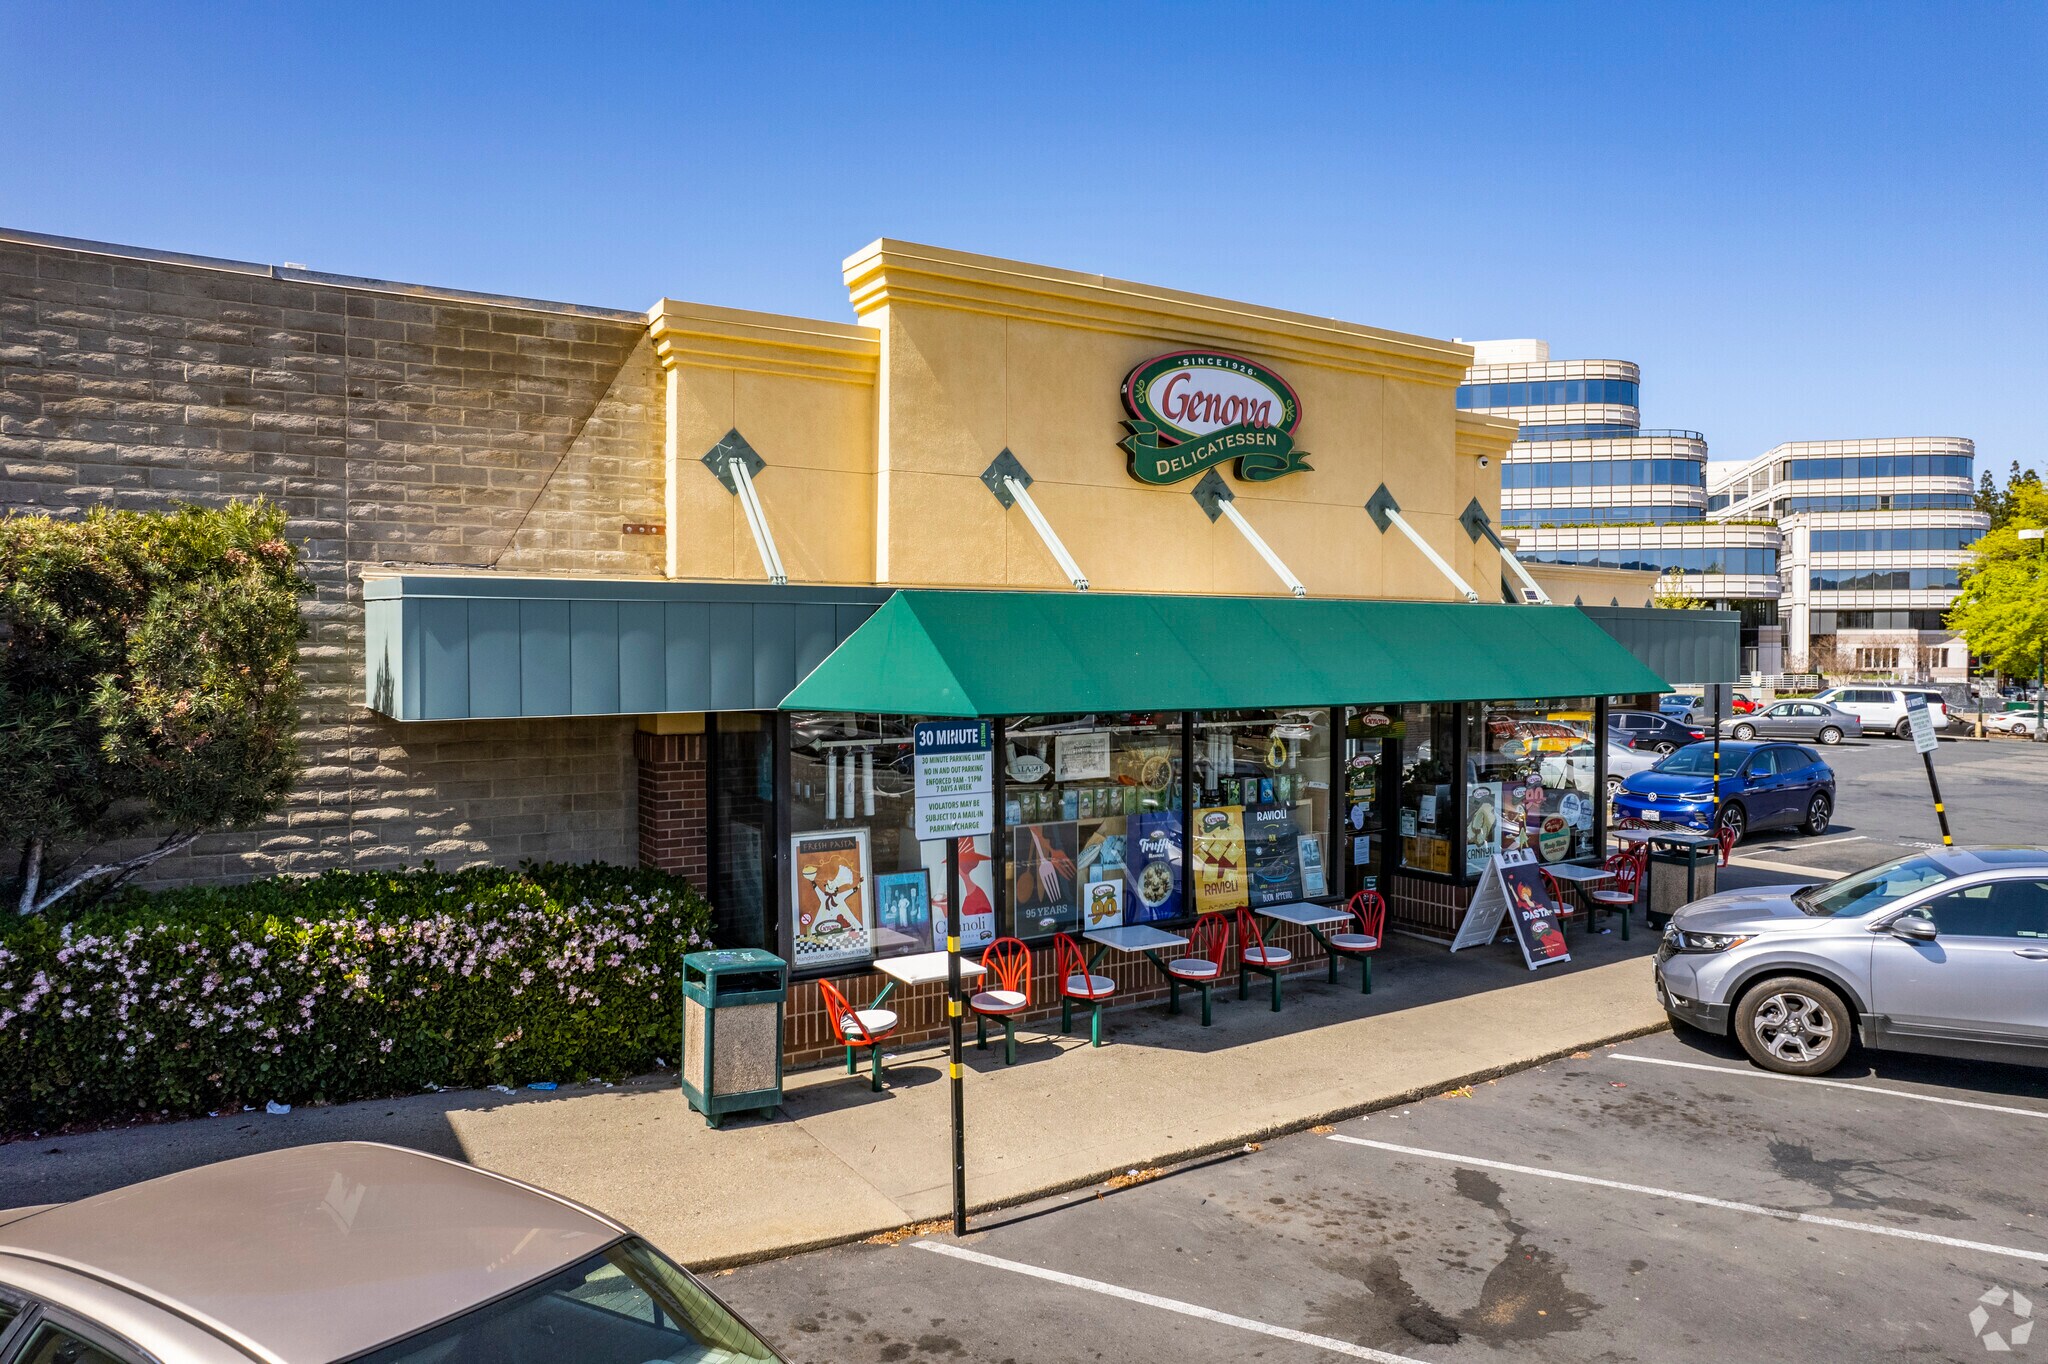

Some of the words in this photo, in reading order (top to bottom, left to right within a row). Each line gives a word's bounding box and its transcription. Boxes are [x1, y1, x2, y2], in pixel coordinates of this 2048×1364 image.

[1162, 372, 1271, 429] Genova
[1156, 432, 1277, 476] DELICATESSEN
[919, 730, 933, 746] 30
[936, 728, 978, 746] MINUTE
[929, 755, 948, 764] MINUTE
[949, 754, 971, 763] PARKING
[926, 777, 952, 786] ENFORCED
[928, 801, 959, 810] VIOLATORS
[926, 813, 949, 822] SUBJECT
[962, 810, 983, 818] MAIL-IN
[1257, 810, 1287, 821] RAVIOLI
[956, 822, 979, 830] CHARGE
[803, 842, 827, 851] FRESH
[830, 839, 854, 848] PASTA
[1139, 838, 1174, 853] Truffle
[1026, 908, 1036, 918] 95
[1037, 904, 1068, 917] YEARS
[1522, 907, 1550, 921] PASTA
[936, 916, 985, 934] Cnoli
